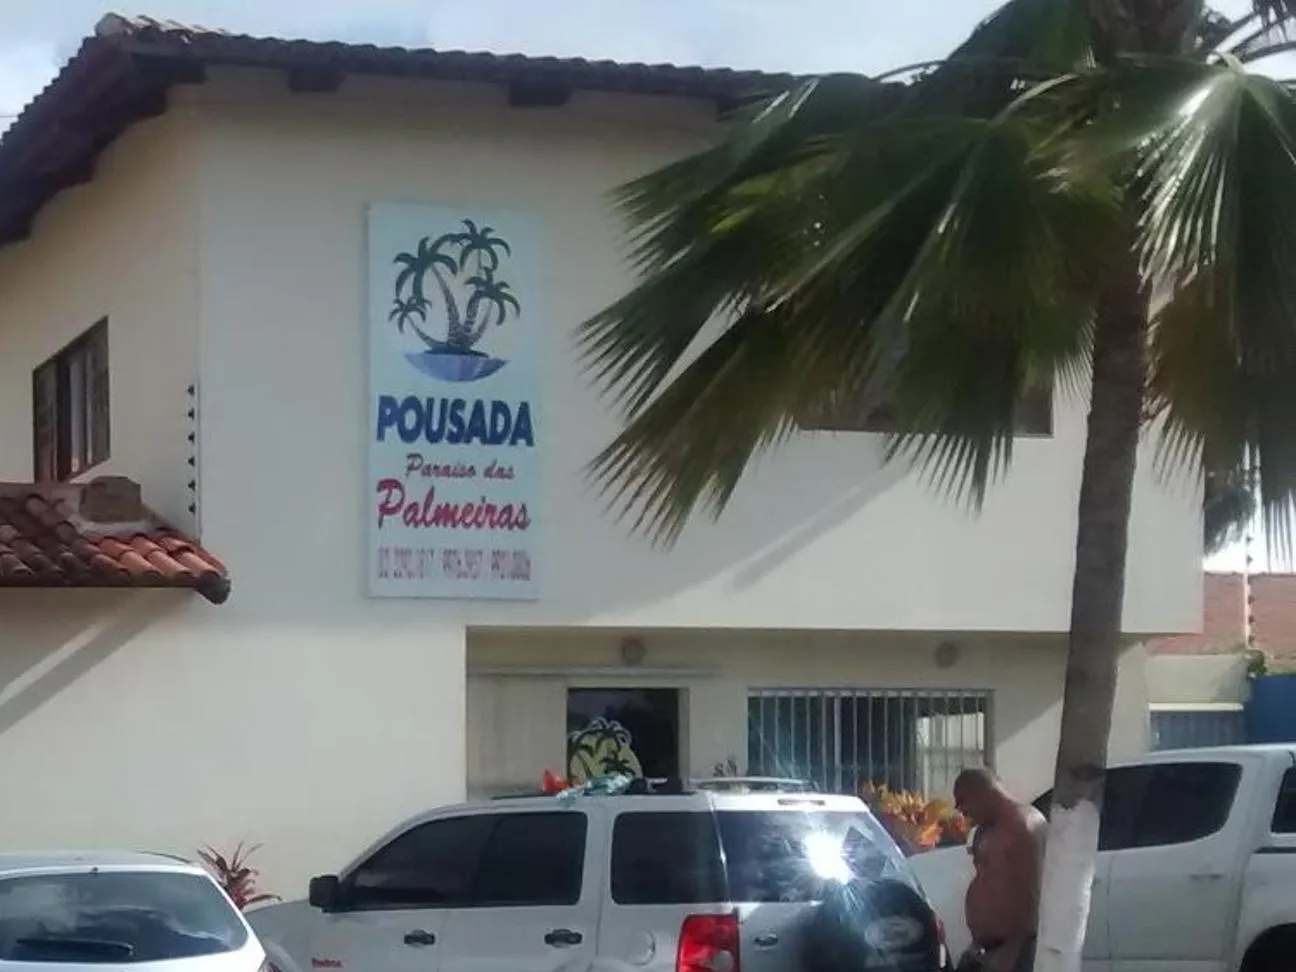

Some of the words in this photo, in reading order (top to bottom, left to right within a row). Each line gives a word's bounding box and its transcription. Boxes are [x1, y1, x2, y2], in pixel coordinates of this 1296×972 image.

[376, 395, 535, 447] POUSADA
[483, 457, 515, 480] das
[376, 478, 531, 531] Palmeiras
